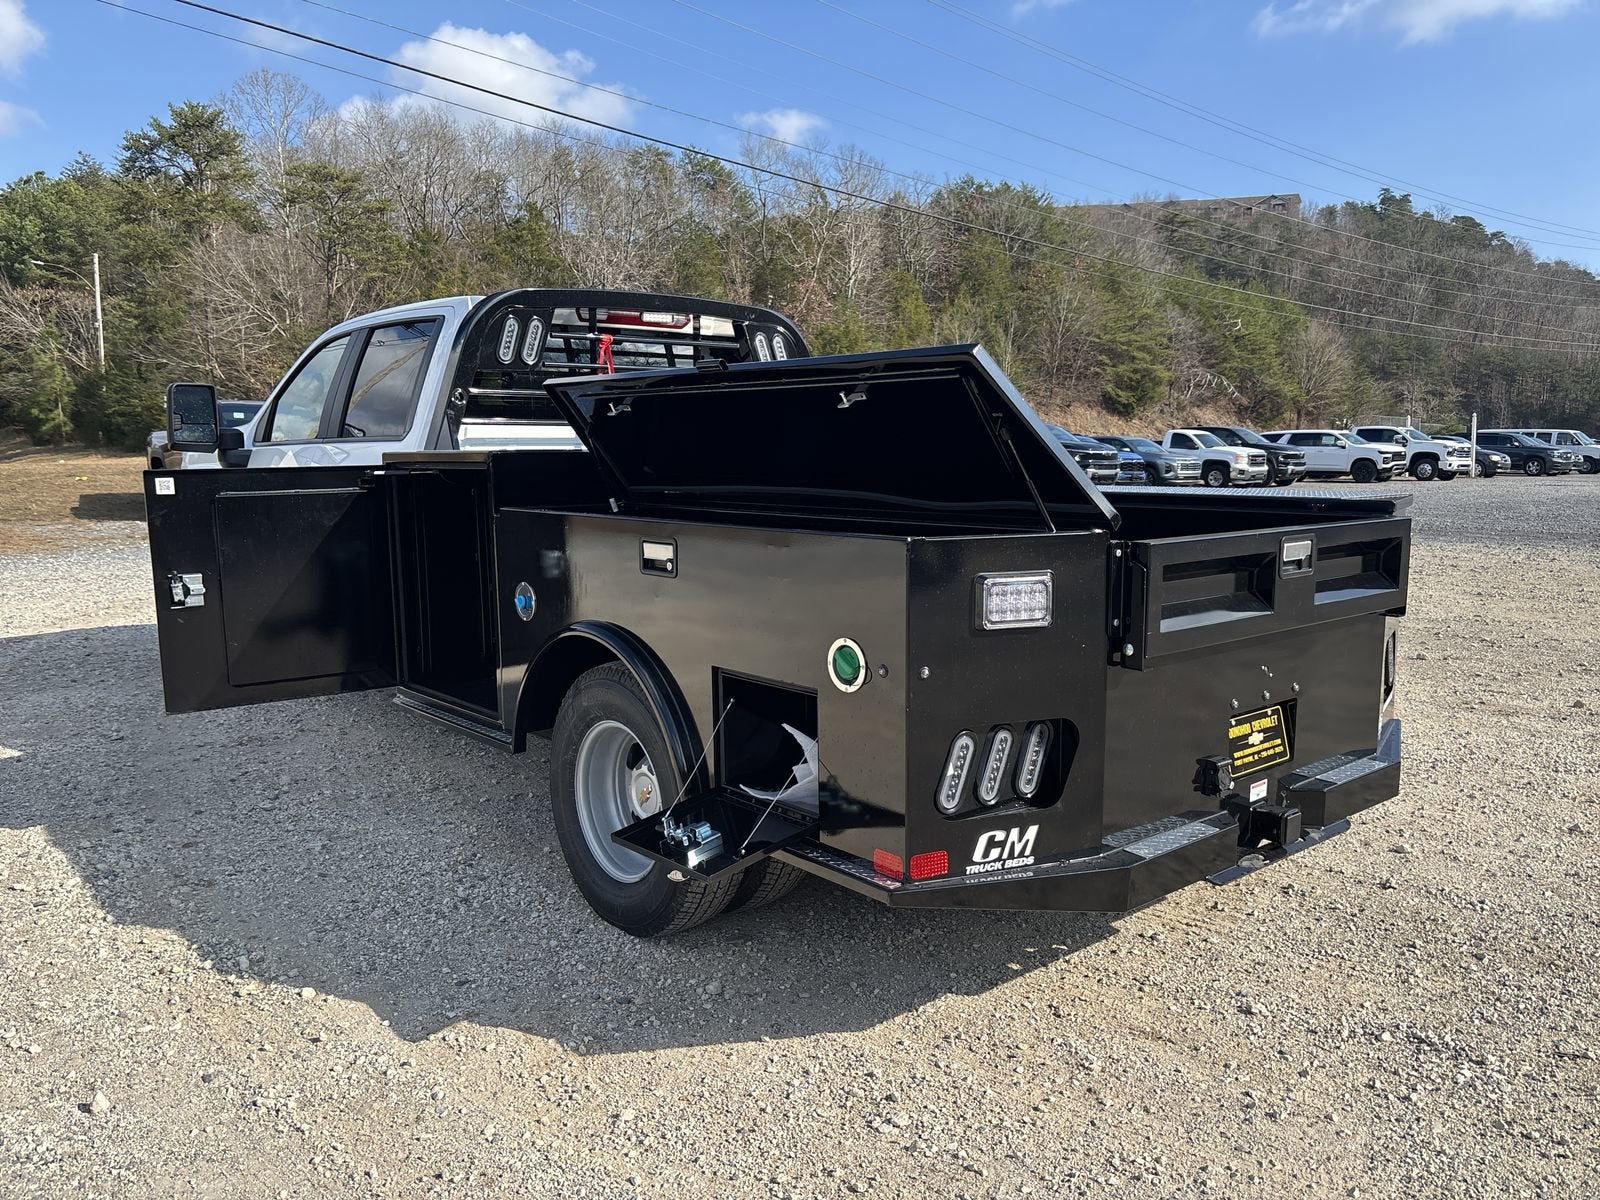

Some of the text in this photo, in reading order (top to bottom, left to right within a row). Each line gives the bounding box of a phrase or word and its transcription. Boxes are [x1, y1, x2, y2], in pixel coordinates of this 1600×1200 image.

[1251, 715, 1278, 732] CHEVROLET
[972, 824, 1040, 863] CM
[965, 856, 1035, 875] TRUCK BEDS
